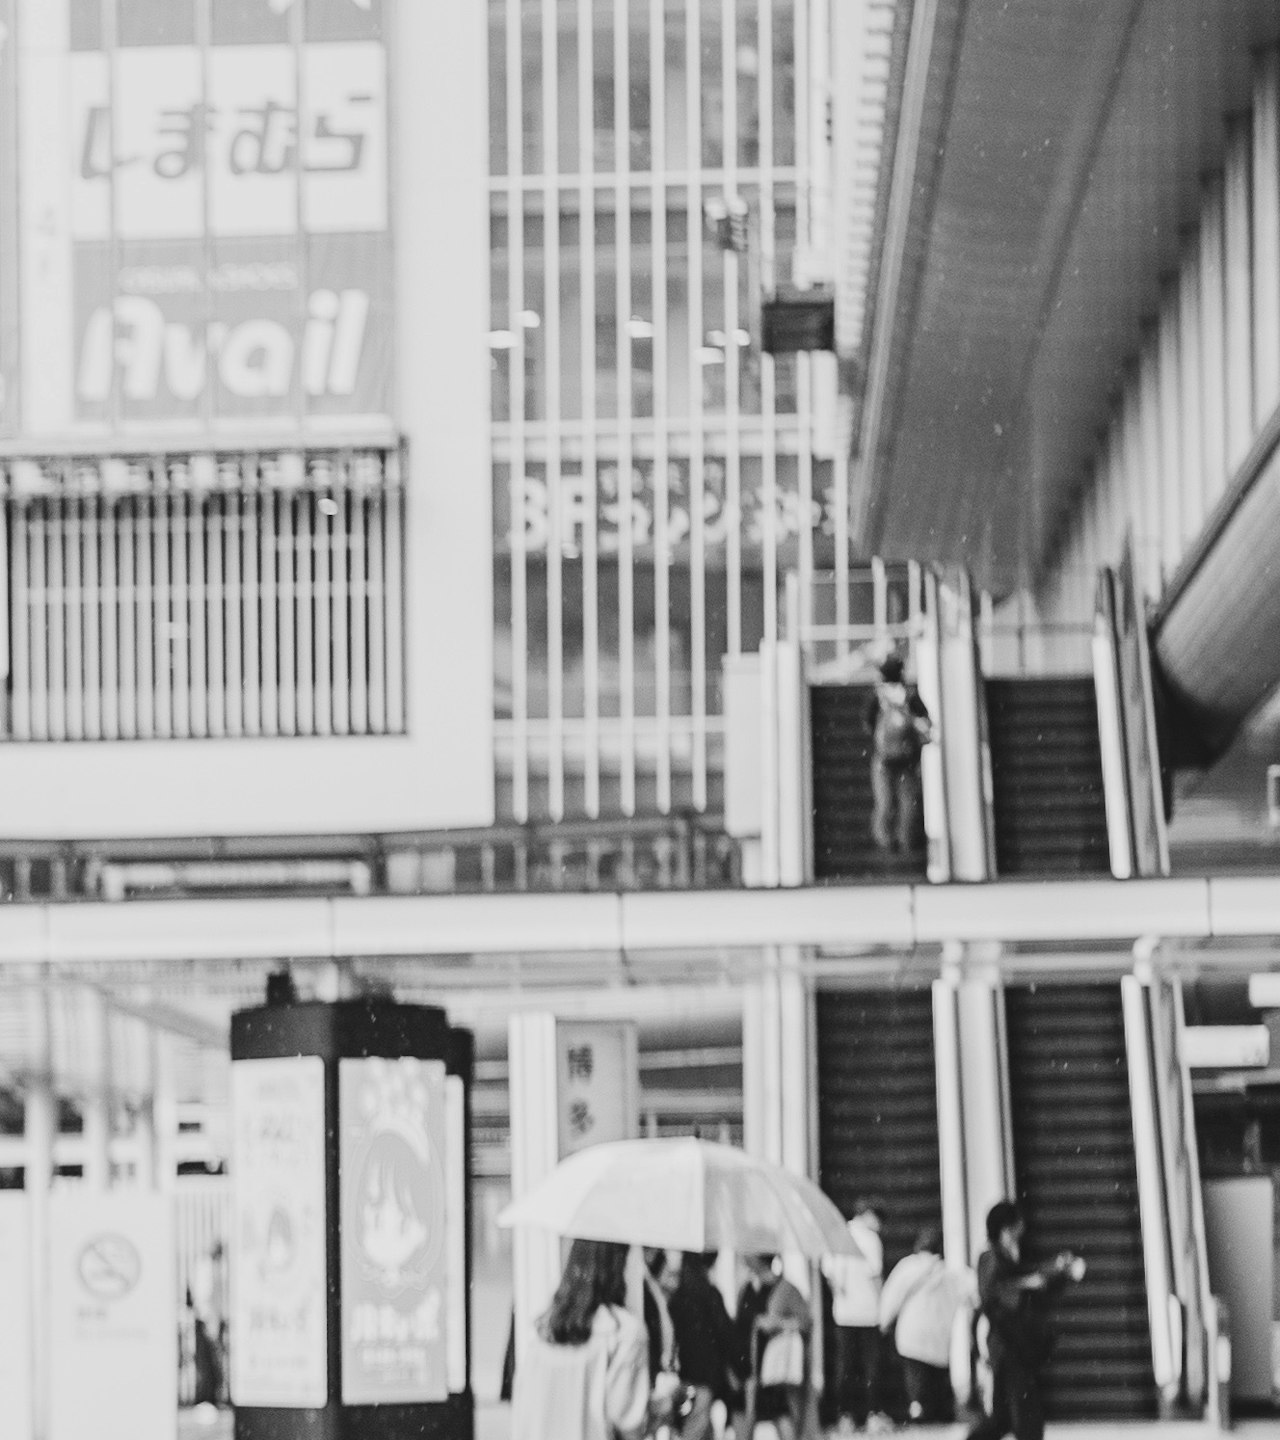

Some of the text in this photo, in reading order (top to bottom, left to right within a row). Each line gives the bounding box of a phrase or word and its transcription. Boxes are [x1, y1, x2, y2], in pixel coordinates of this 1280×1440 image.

[80, 94, 374, 180] しまむら
[79, 287, 371, 402] Avail
